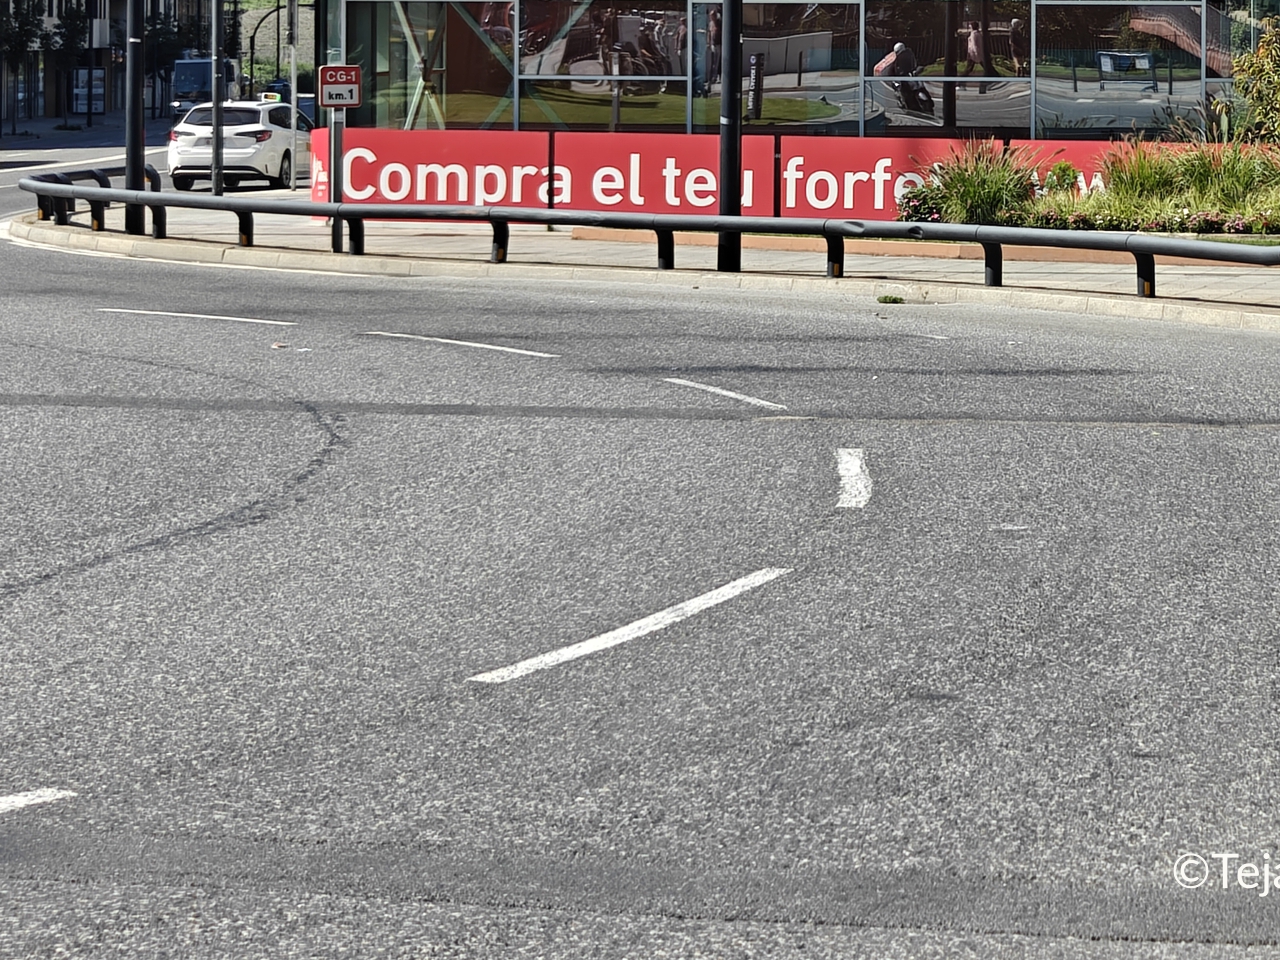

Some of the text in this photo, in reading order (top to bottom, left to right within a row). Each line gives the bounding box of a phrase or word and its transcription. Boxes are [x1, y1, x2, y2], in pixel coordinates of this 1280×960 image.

[327, 71, 356, 82] CG-1
[341, 147, 573, 207] Compra
[592, 152, 645, 206] el
